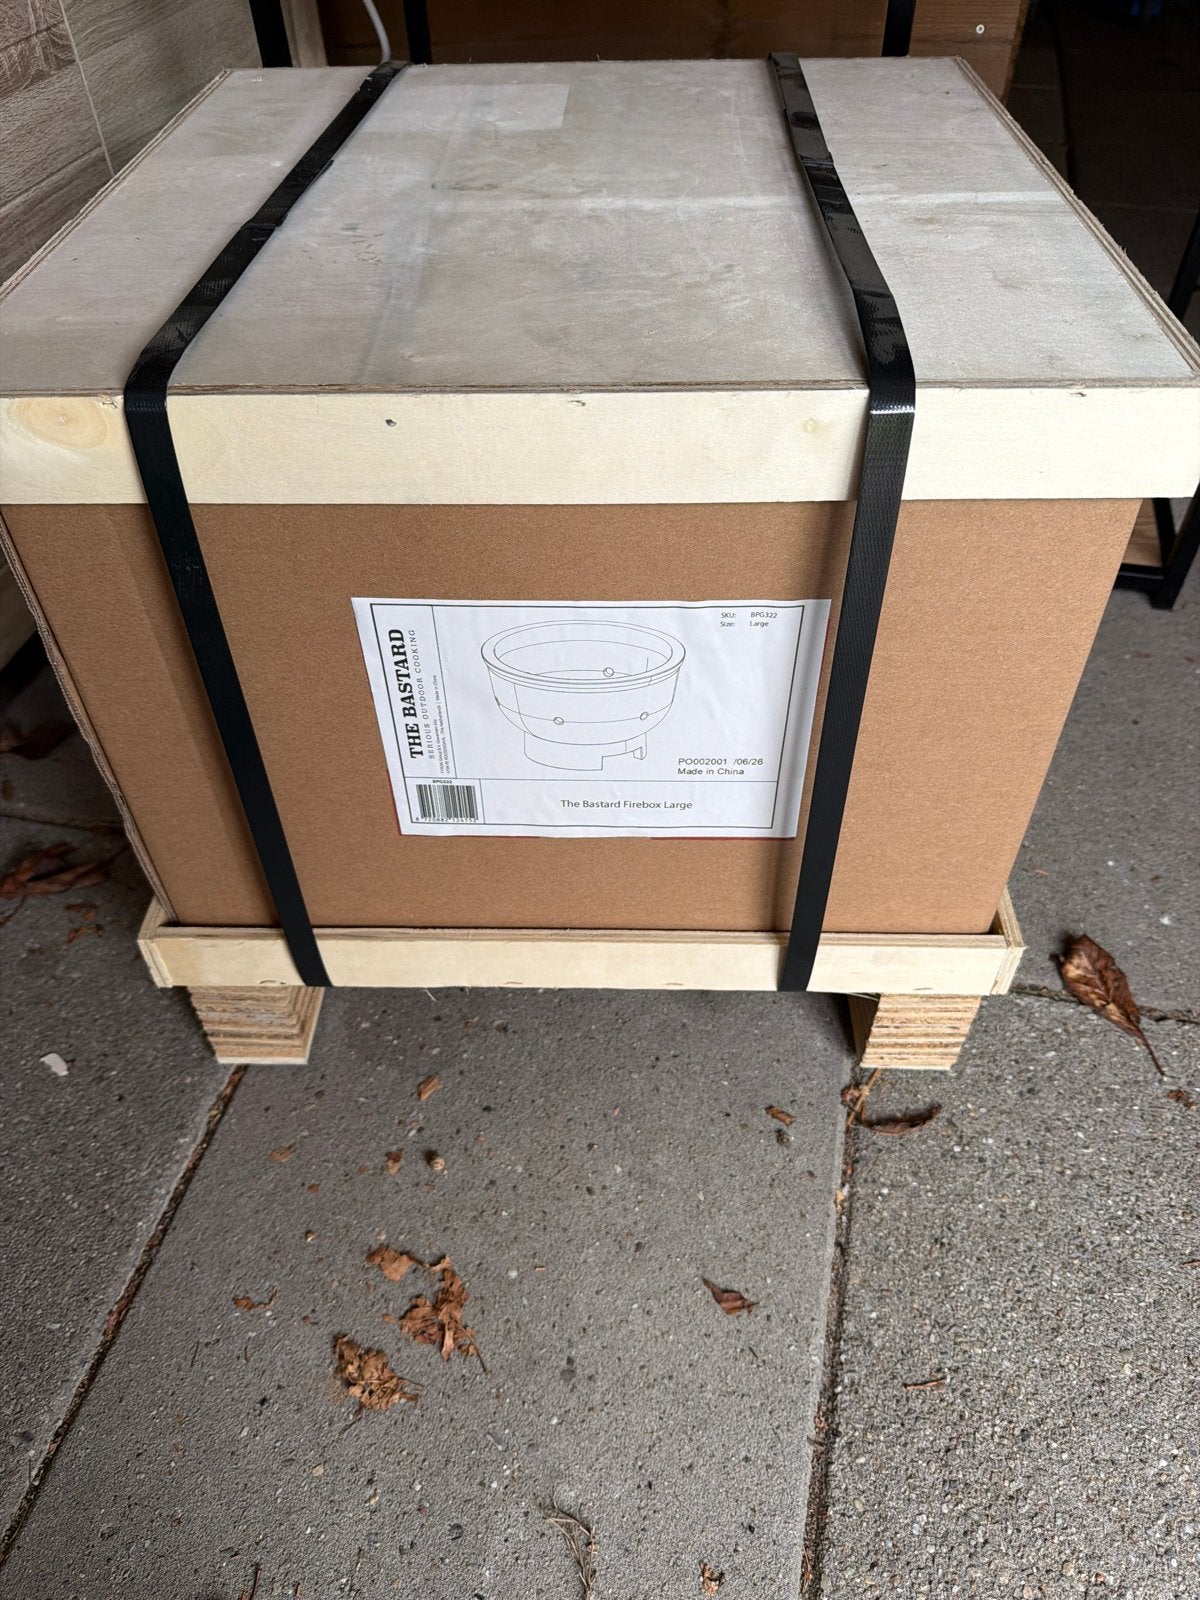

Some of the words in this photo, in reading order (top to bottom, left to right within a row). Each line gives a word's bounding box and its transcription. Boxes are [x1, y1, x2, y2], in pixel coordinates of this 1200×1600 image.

[720, 620, 736, 628] Size:
[749, 620, 770, 628] Large
[750, 611, 778, 619] BPG322
[408, 629, 422, 674] COOKING
[388, 628, 418, 718] BASTARD
[416, 677, 429, 720] OUTDOOR
[404, 723, 424, 759] THE
[423, 723, 435, 760] SERIOUS
[677, 767, 704, 775] Made
[705, 767, 715, 775] in
[717, 767, 745, 775] China
[678, 757, 727, 766] PO002001
[733, 757, 764, 766] /06/26
[560, 799, 580, 808] The
[582, 799, 621, 809] Bastard
[623, 800, 661, 809] Firebox
[663, 800, 693, 811] Large
